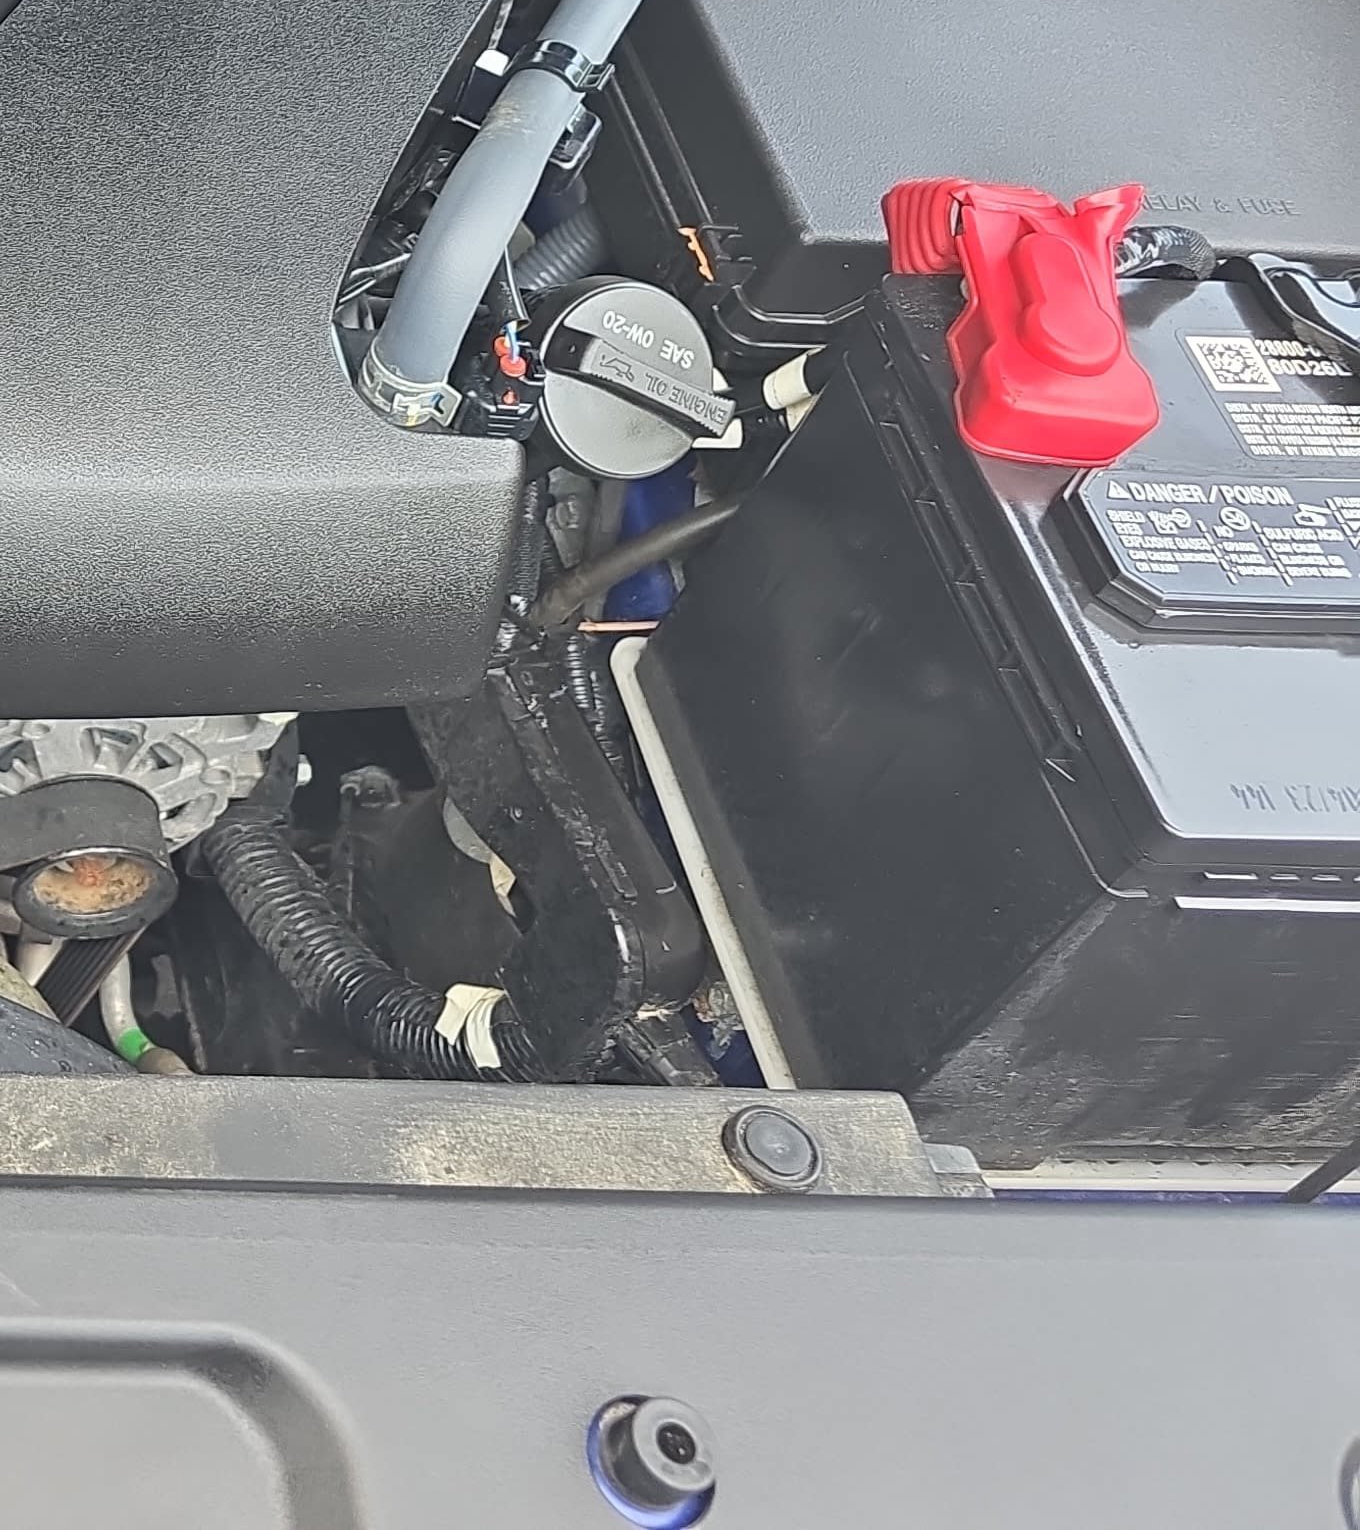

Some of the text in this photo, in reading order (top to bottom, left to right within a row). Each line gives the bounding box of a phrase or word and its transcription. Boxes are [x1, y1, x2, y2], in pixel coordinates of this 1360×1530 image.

[1211, 197, 1231, 214] &
[1236, 197, 1301, 216] FUSE
[602, 310, 695, 369] SAE 0W-20
[1267, 358, 1353, 376] 80D26L
[645, 372, 729, 425] ENGINE OIL
[1127, 482, 1208, 504] DANGER
[1219, 484, 1294, 505] POISON
